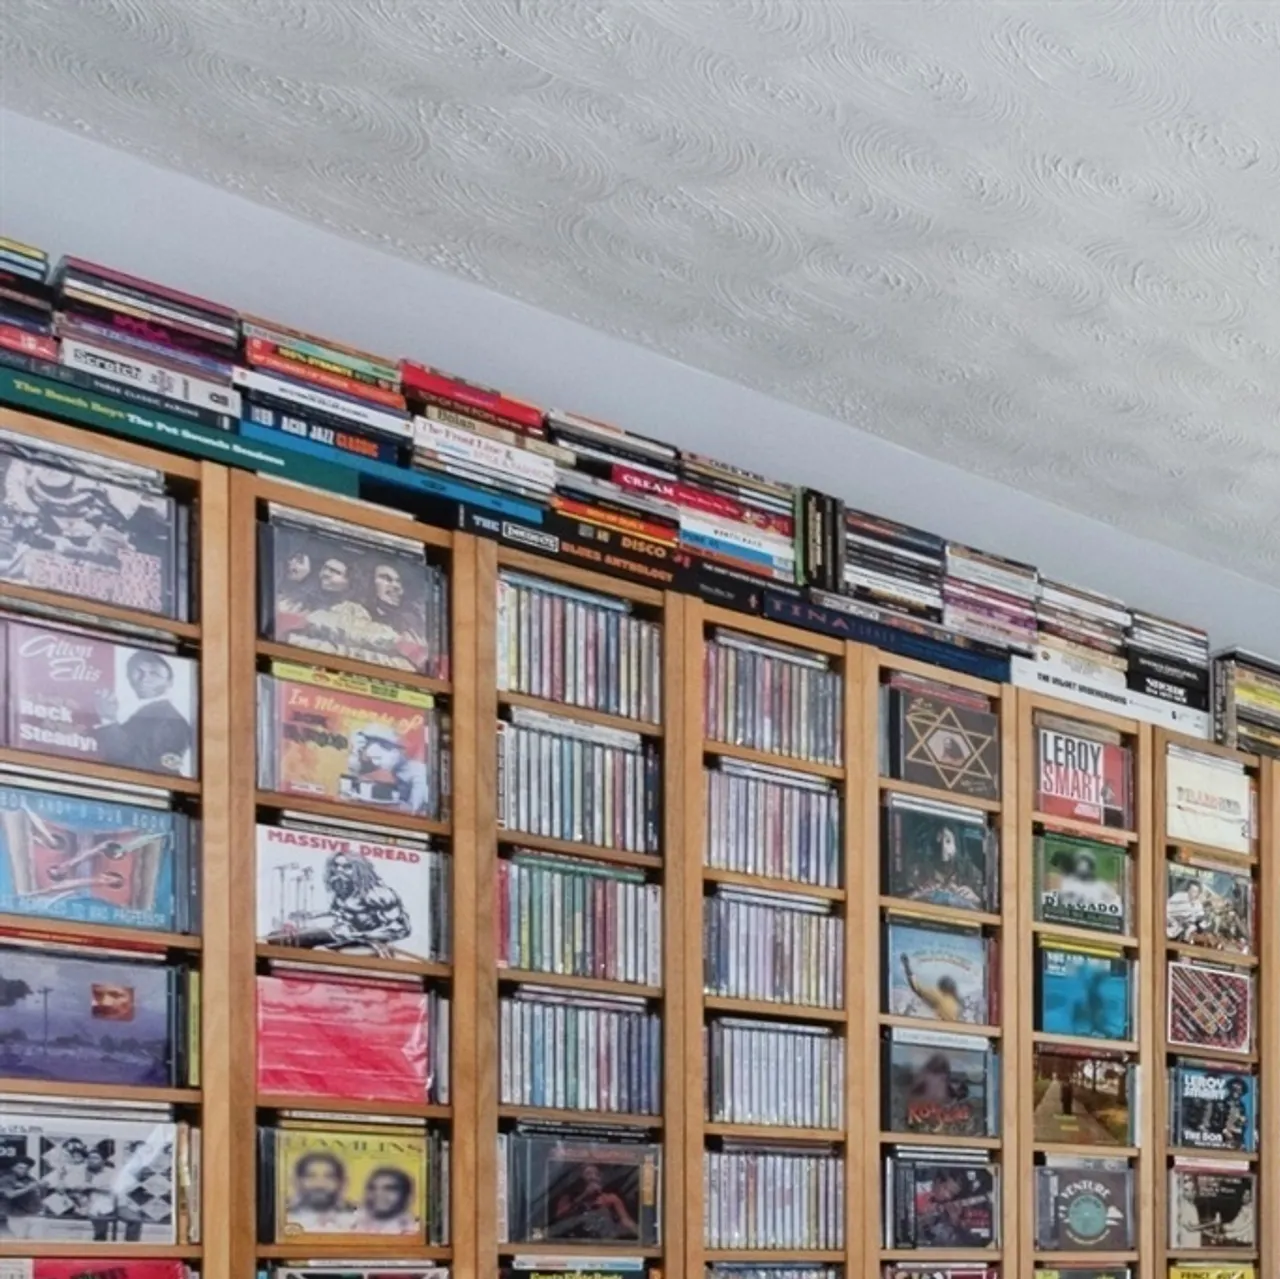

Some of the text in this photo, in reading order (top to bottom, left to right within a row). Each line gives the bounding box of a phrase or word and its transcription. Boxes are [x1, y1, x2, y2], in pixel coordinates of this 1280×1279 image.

[14, 379, 126, 419] The Beach Boys
[127, 413, 285, 467] The Pet Sounds Sessions
[309, 424, 335, 446] JAZZ
[622, 473, 675, 497] CREAM
[472, 514, 499, 532] THE
[561, 544, 601, 565] BLUES
[620, 536, 666, 560] DISCO
[771, 597, 850, 631] TINA
[49, 657, 103, 683] Ellis
[21, 699, 72, 723] Rock
[1043, 731, 1101, 778] LEROY
[1043, 763, 1101, 804] SMART
[267, 829, 421, 864] MASSIVE DREAD
